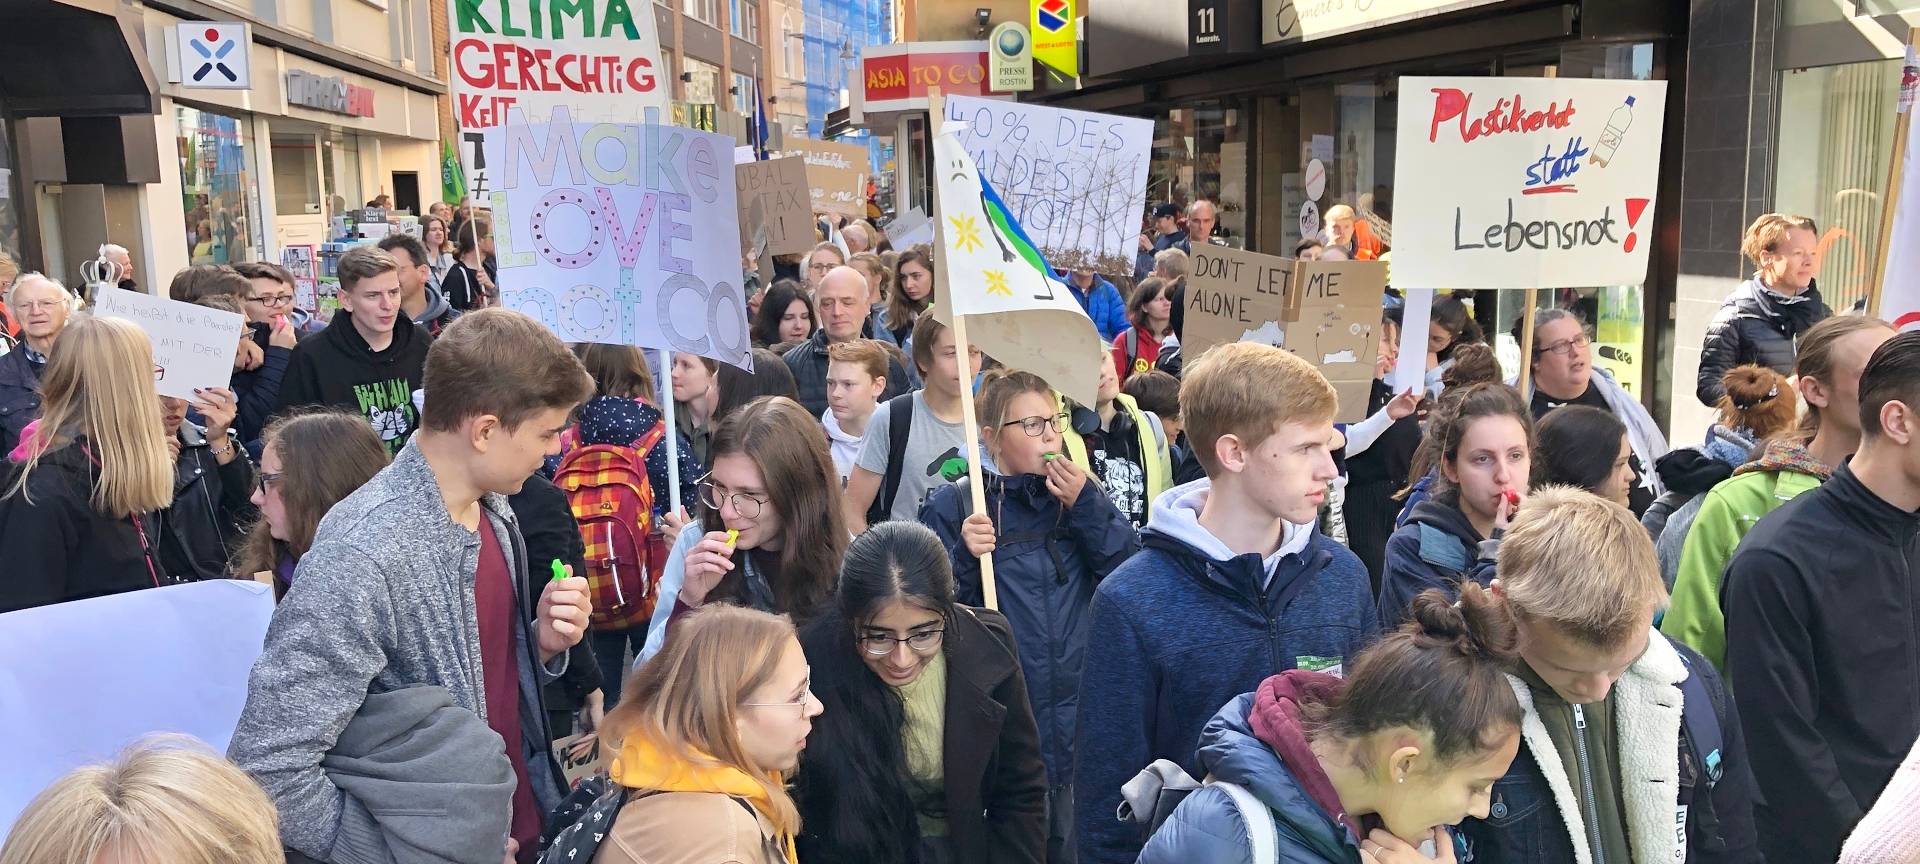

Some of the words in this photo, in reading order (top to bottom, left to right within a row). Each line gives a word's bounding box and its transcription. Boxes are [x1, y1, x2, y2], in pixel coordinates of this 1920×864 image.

[454, 0, 640, 40] KLIMA
[1197, 8, 1215, 34] 11
[867, 66, 906, 88] ASIA
[912, 65, 941, 86] TO
[948, 63, 985, 85] GO
[1000, 67, 1026, 76] PRESSE
[1000, 78, 1027, 86] ROSTIN
[1056, 115, 1125, 151] DES
[1429, 87, 1576, 144] Plastikverbot
[504, 105, 719, 203] Make
[970, 150, 1070, 192] ALDES
[1525, 136, 1589, 186] statt
[761, 187, 801, 214] TAX
[1013, 193, 1073, 234] TOT
[491, 187, 692, 276] LOVE
[1194, 254, 1245, 283] DON'T
[1256, 265, 1291, 298] LET
[1306, 272, 1342, 298] ME
[105, 295, 127, 313] Wie
[175, 311, 197, 326] die
[501, 267, 641, 346] not
[1190, 288, 1252, 323] ALONE
[160, 337, 185, 351] MIT
[192, 342, 222, 359] DER
